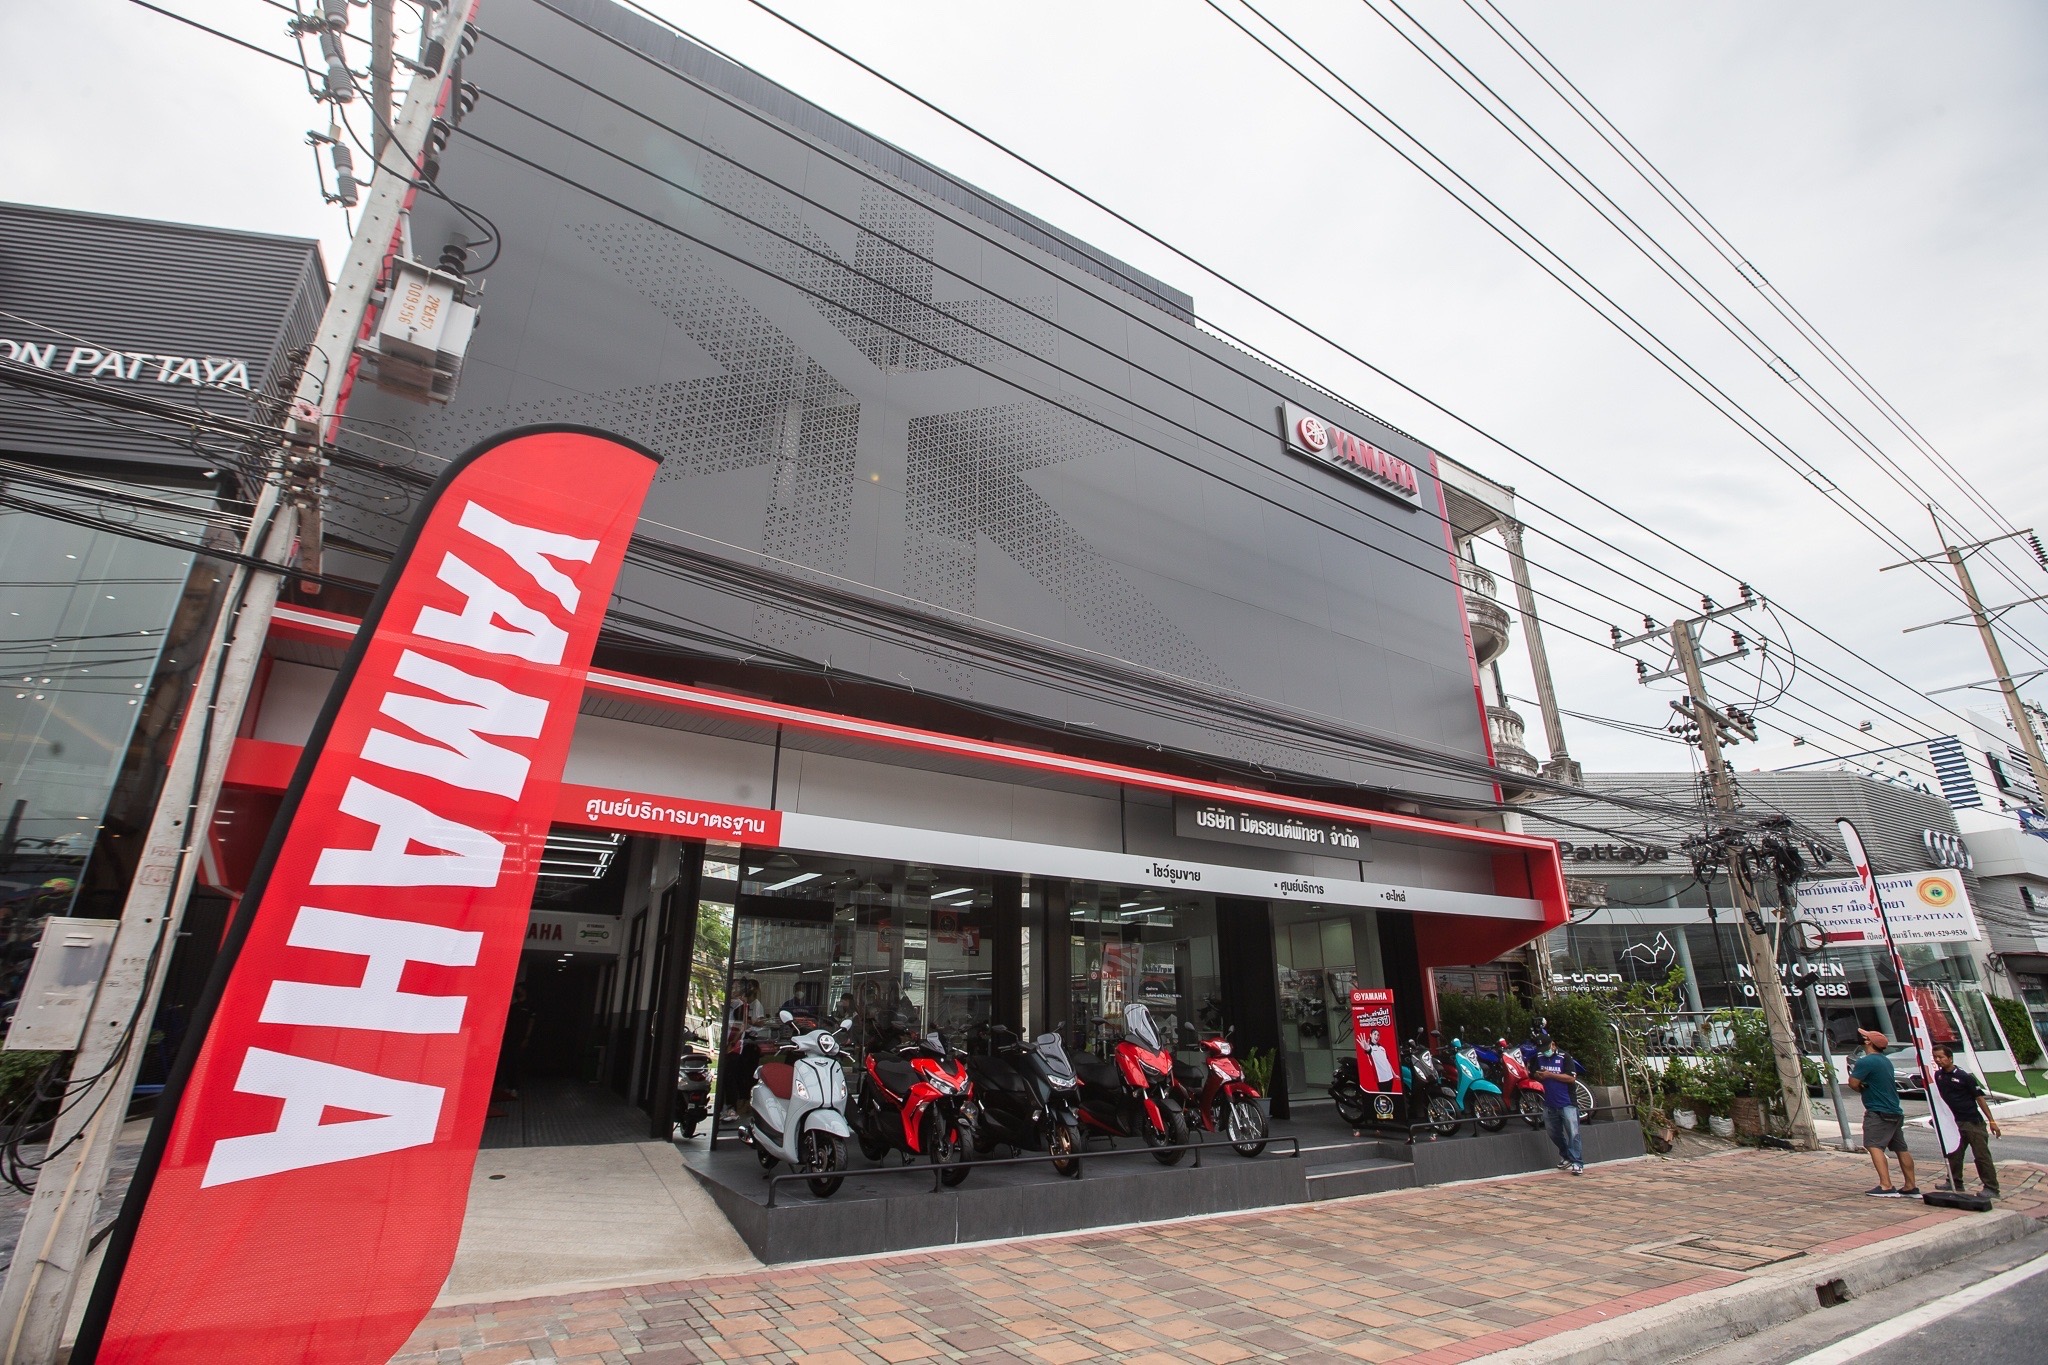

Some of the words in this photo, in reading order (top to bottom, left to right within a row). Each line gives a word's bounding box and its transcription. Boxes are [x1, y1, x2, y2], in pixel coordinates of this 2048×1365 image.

[65, 346, 252, 392] PATTAYA
[1327, 426, 1418, 495] YAMAHA
[585, 797, 765, 836] ศูนย์บริการมาตรฐาน
[1196, 807, 1236, 831] บริษัท
[1240, 812, 1325, 844] มิตรยนต์พัทยา
[1329, 825, 1360, 849] จำกัด
[201, 500, 600, 1190] YAMAHA
[1560, 841, 1669, 865] Pattaya
[1152, 862, 1201, 884] โชว์รูมขาย
[1280, 878, 1325, 896] ศูนย์บริการ
[1385, 889, 1406, 902] อะไหล่
[1832, 904, 1844, 914] 57
[1847, 899, 1905, 913] เมืองทยา
[1808, 917, 1862, 927] LLPOWER
[1862, 911, 1963, 924] INSTUTE-PATTAYA
[527, 922, 562, 941] AHA
[1552, 972, 1624, 983] e-tron
[1737, 963, 1788, 977] NW
[1361, 992, 1388, 1001] YAMAHA
